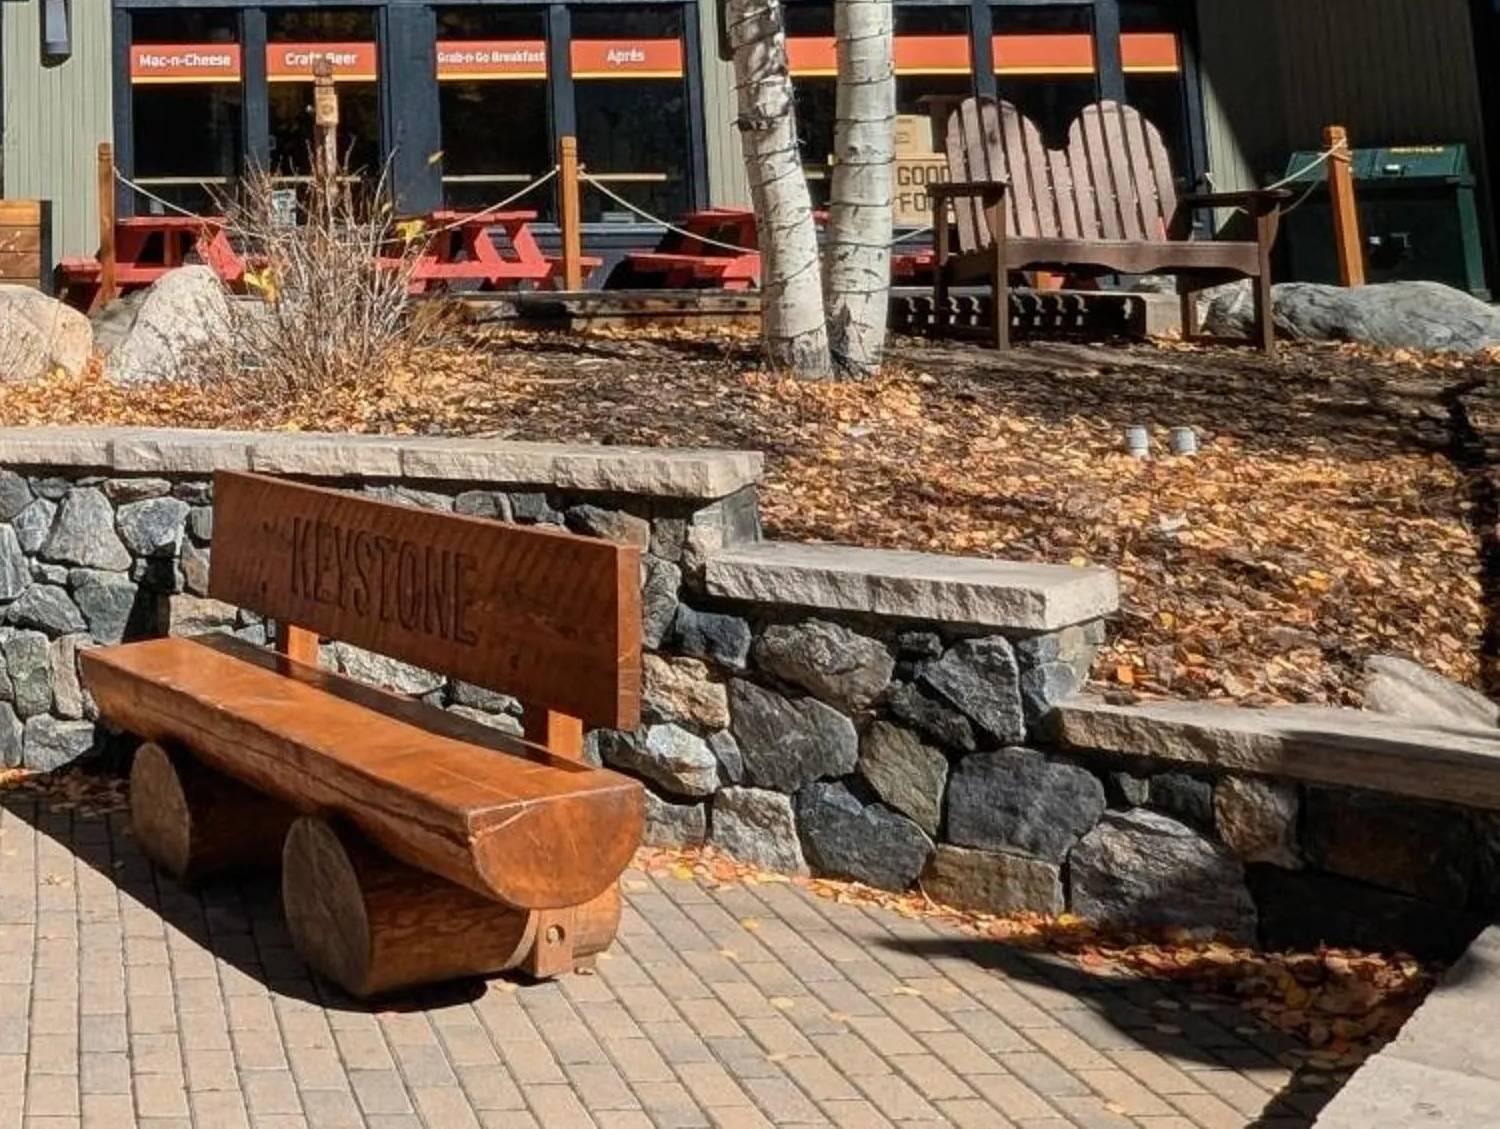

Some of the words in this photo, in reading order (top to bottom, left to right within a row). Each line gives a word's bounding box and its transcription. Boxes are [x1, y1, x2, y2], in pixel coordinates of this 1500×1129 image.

[139, 53, 231, 67] Mac-n-Cheese
[491, 50, 545, 63] Breakfast
[293, 519, 478, 647] KEYSTONE
